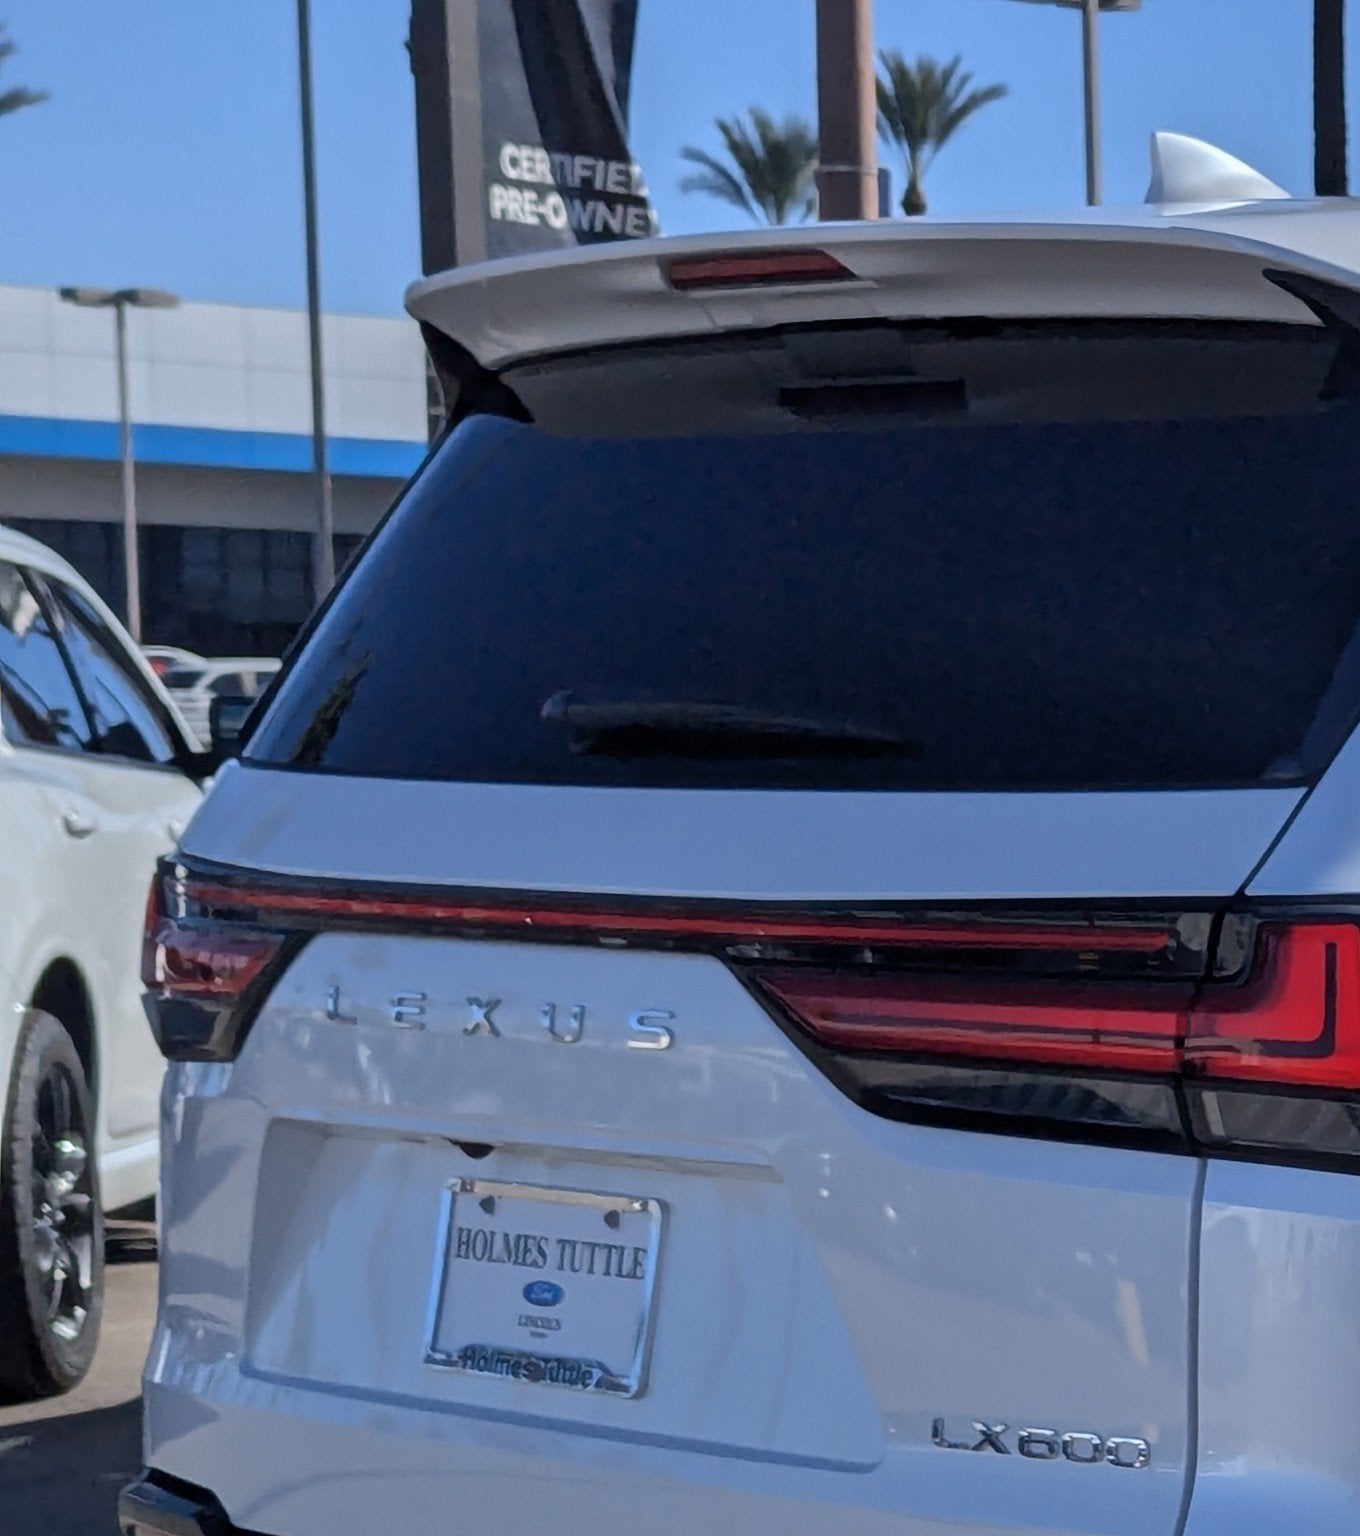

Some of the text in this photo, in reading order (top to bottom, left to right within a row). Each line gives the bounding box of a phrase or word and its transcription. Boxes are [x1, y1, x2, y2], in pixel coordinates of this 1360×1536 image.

[326, 984, 677, 1050] LEXUS
[454, 1226, 648, 1280] HOLMES TUTTLE
